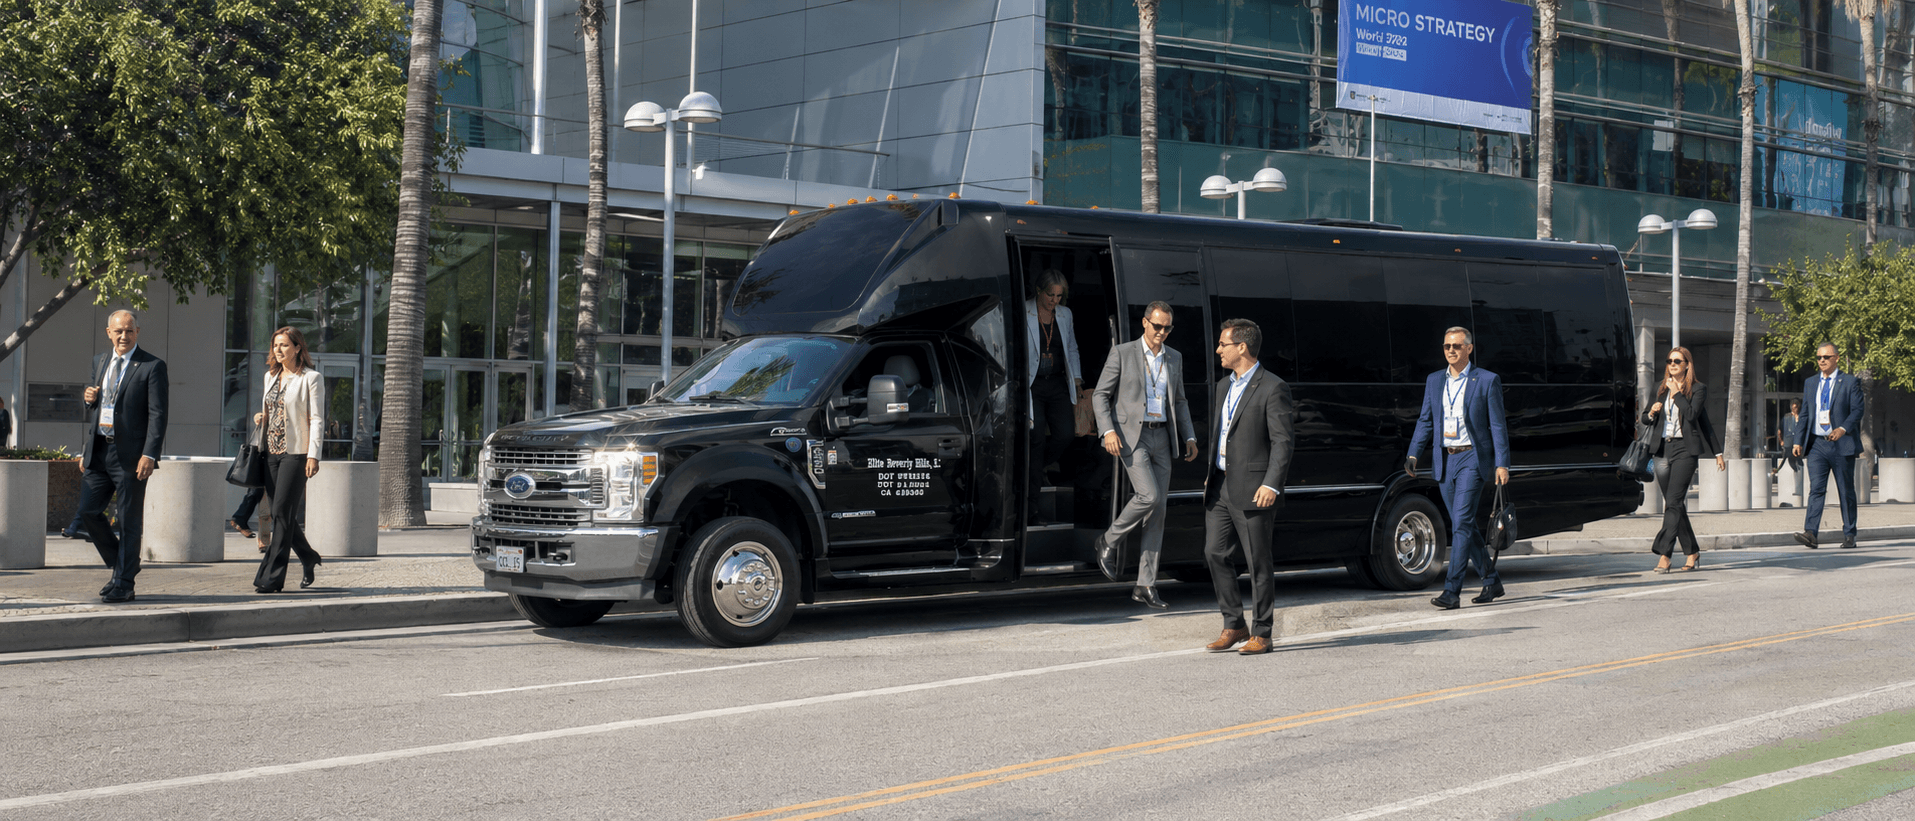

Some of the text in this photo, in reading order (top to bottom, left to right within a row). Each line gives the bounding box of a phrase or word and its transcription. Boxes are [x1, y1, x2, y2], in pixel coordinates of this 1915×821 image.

[1356, 3, 1496, 43] MICRO STRATEGY
[1356, 27, 1384, 43] World
[878, 472, 895, 481] DOT
